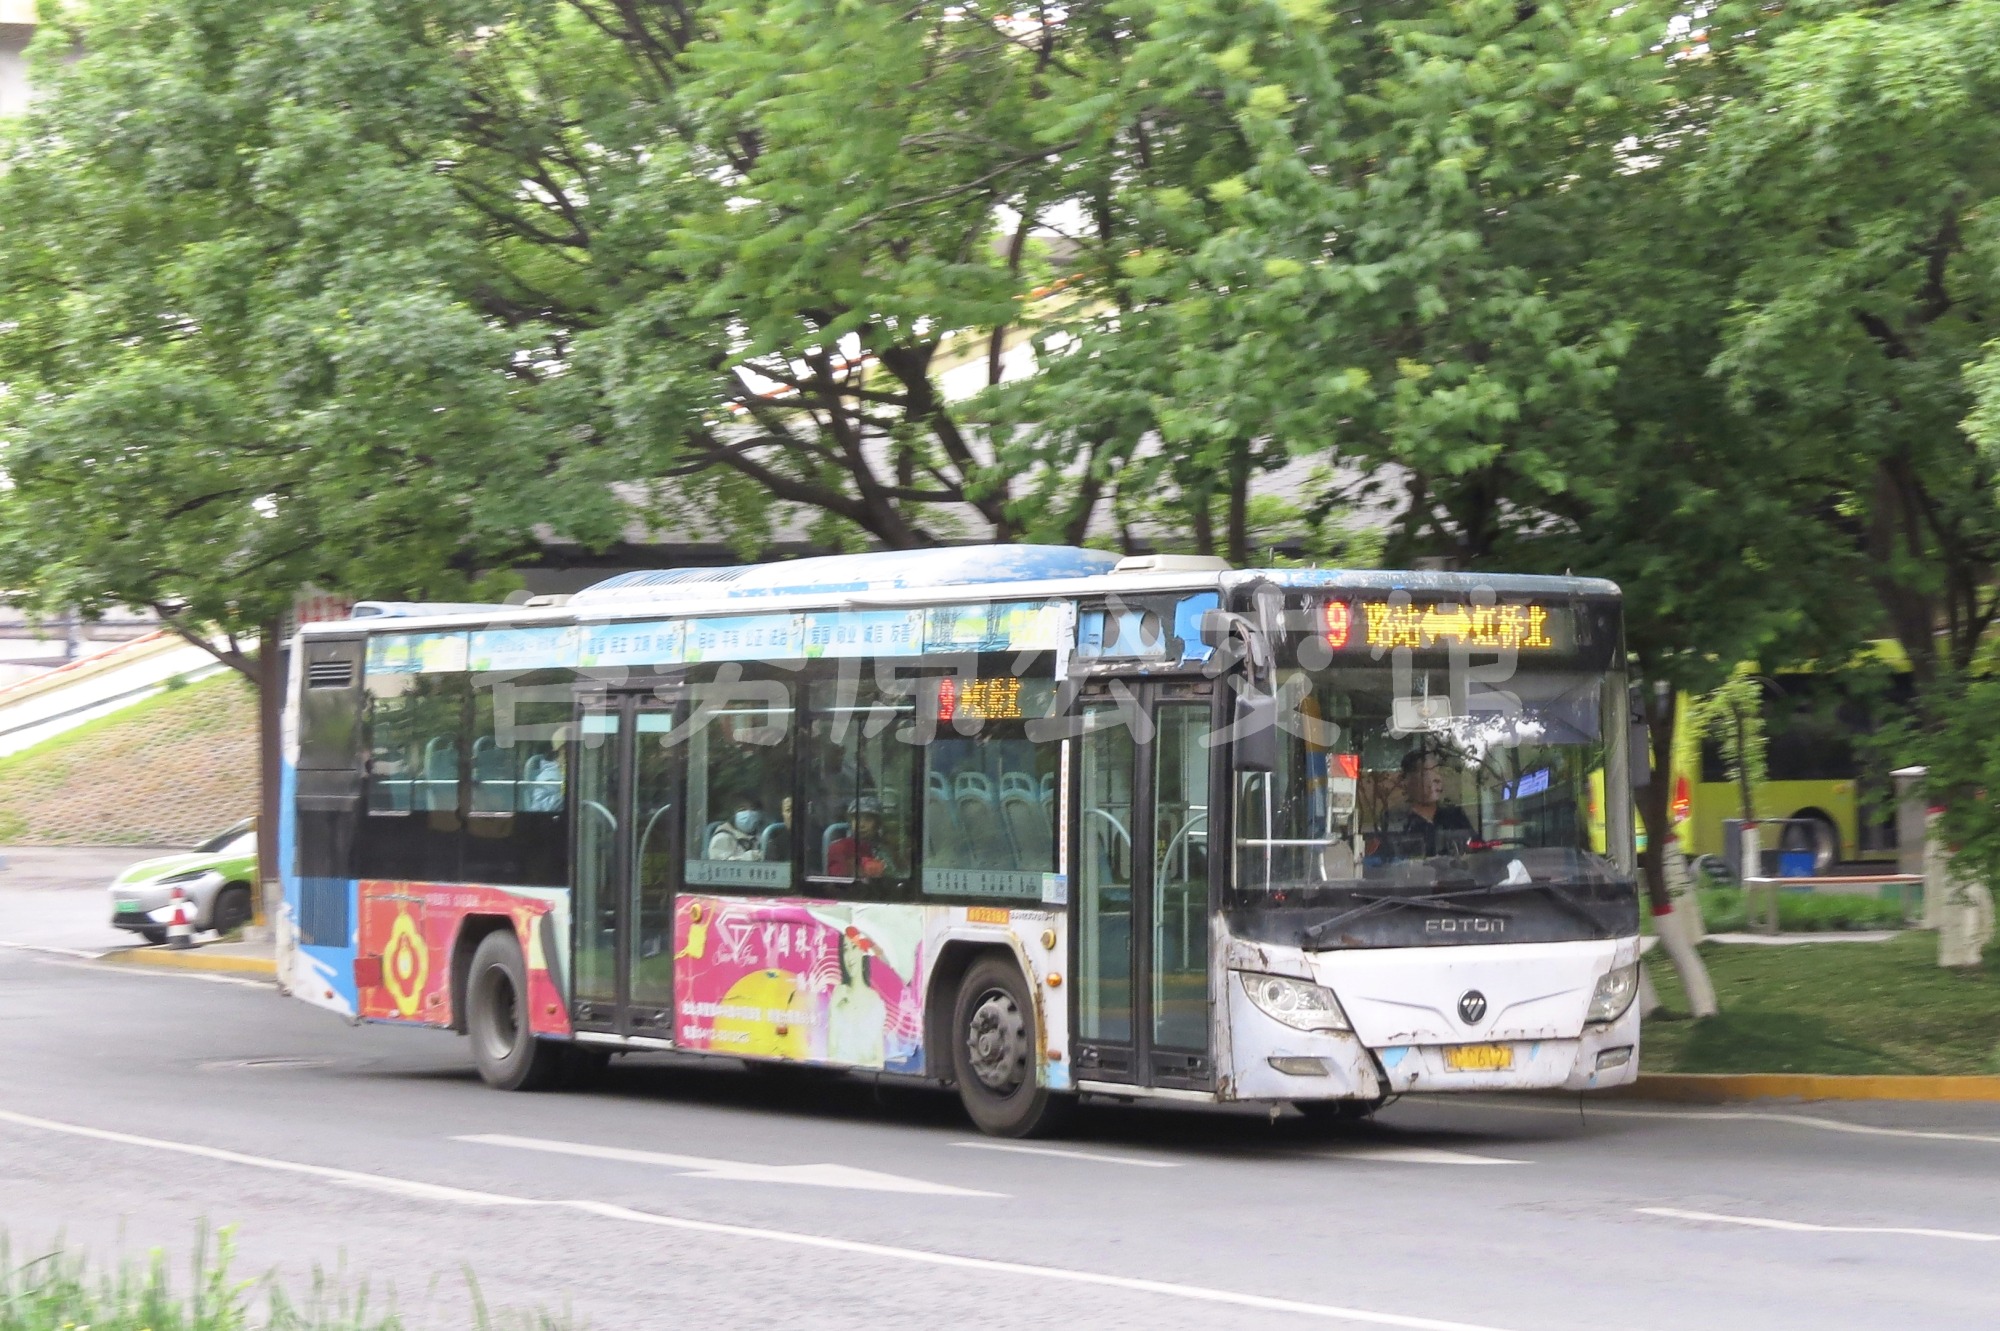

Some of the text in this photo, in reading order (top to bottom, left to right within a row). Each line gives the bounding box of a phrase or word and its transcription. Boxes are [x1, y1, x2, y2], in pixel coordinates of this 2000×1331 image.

[1326, 601, 1349, 648] 9
[938, 679, 955, 720] 9
[1425, 917, 1505, 933] FOTON
